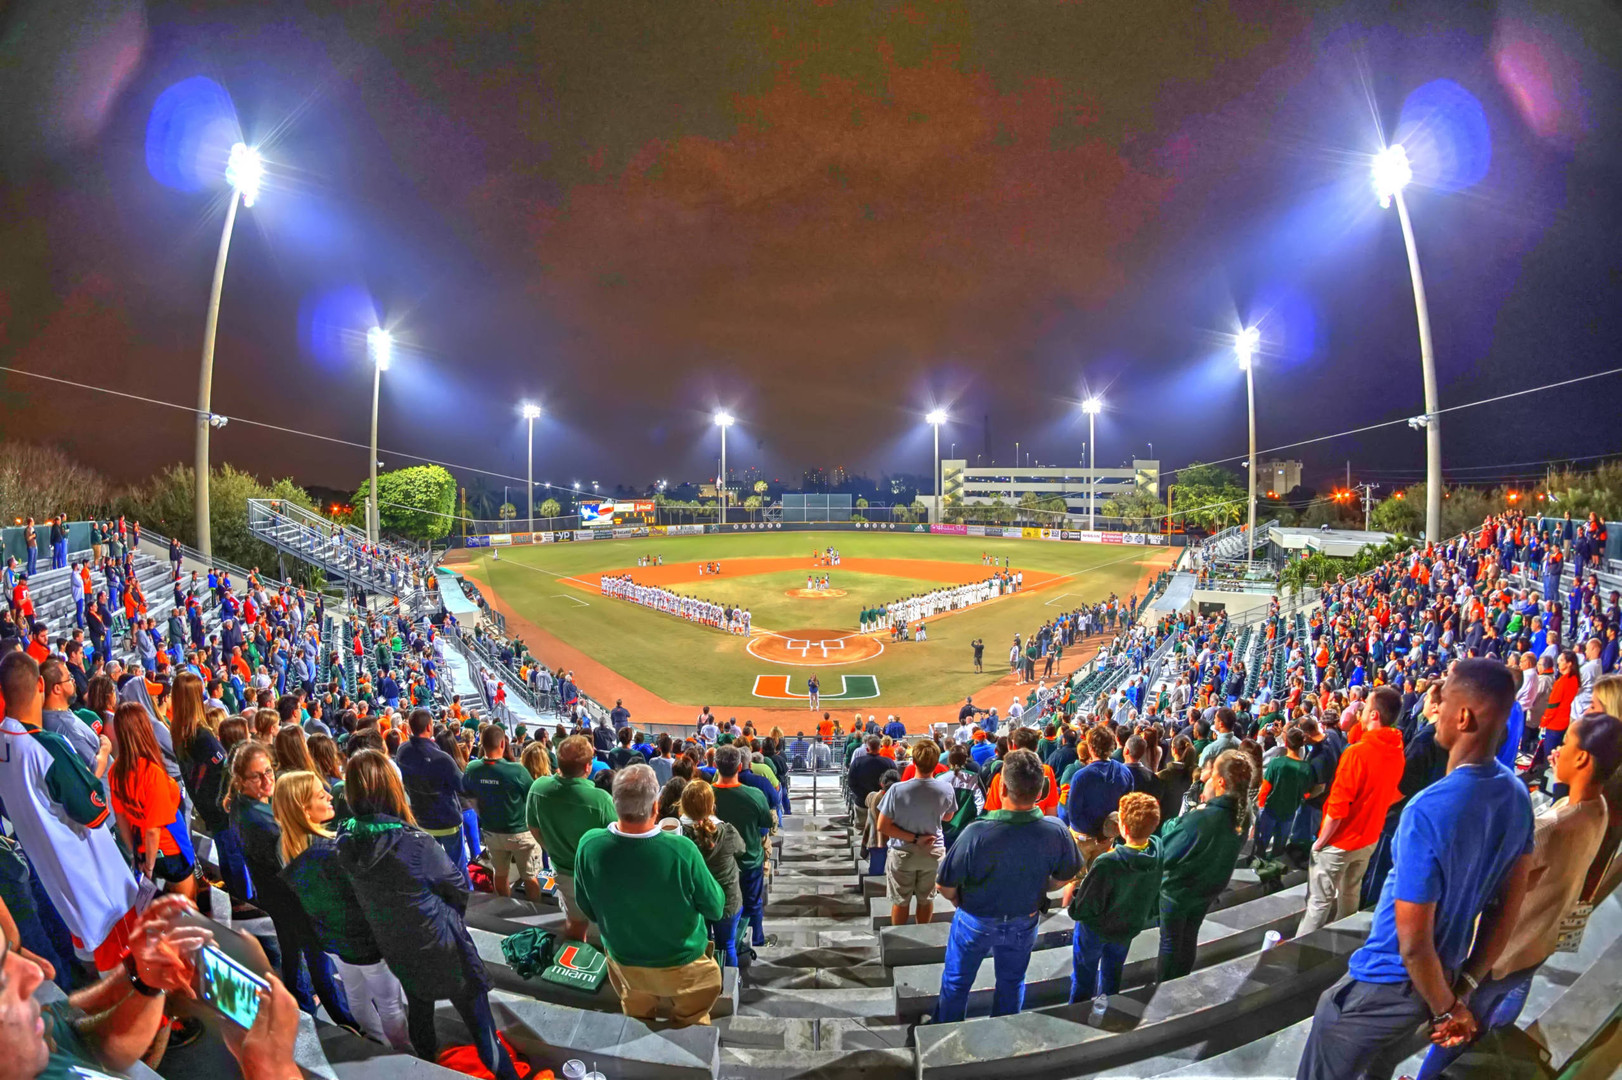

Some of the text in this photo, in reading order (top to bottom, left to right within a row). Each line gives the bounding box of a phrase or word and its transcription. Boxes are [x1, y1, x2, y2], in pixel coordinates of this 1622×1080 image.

[558, 531, 570, 540] yp
[752, 675, 880, 700] U
[559, 945, 607, 974] U
[551, 965, 597, 983] miami
